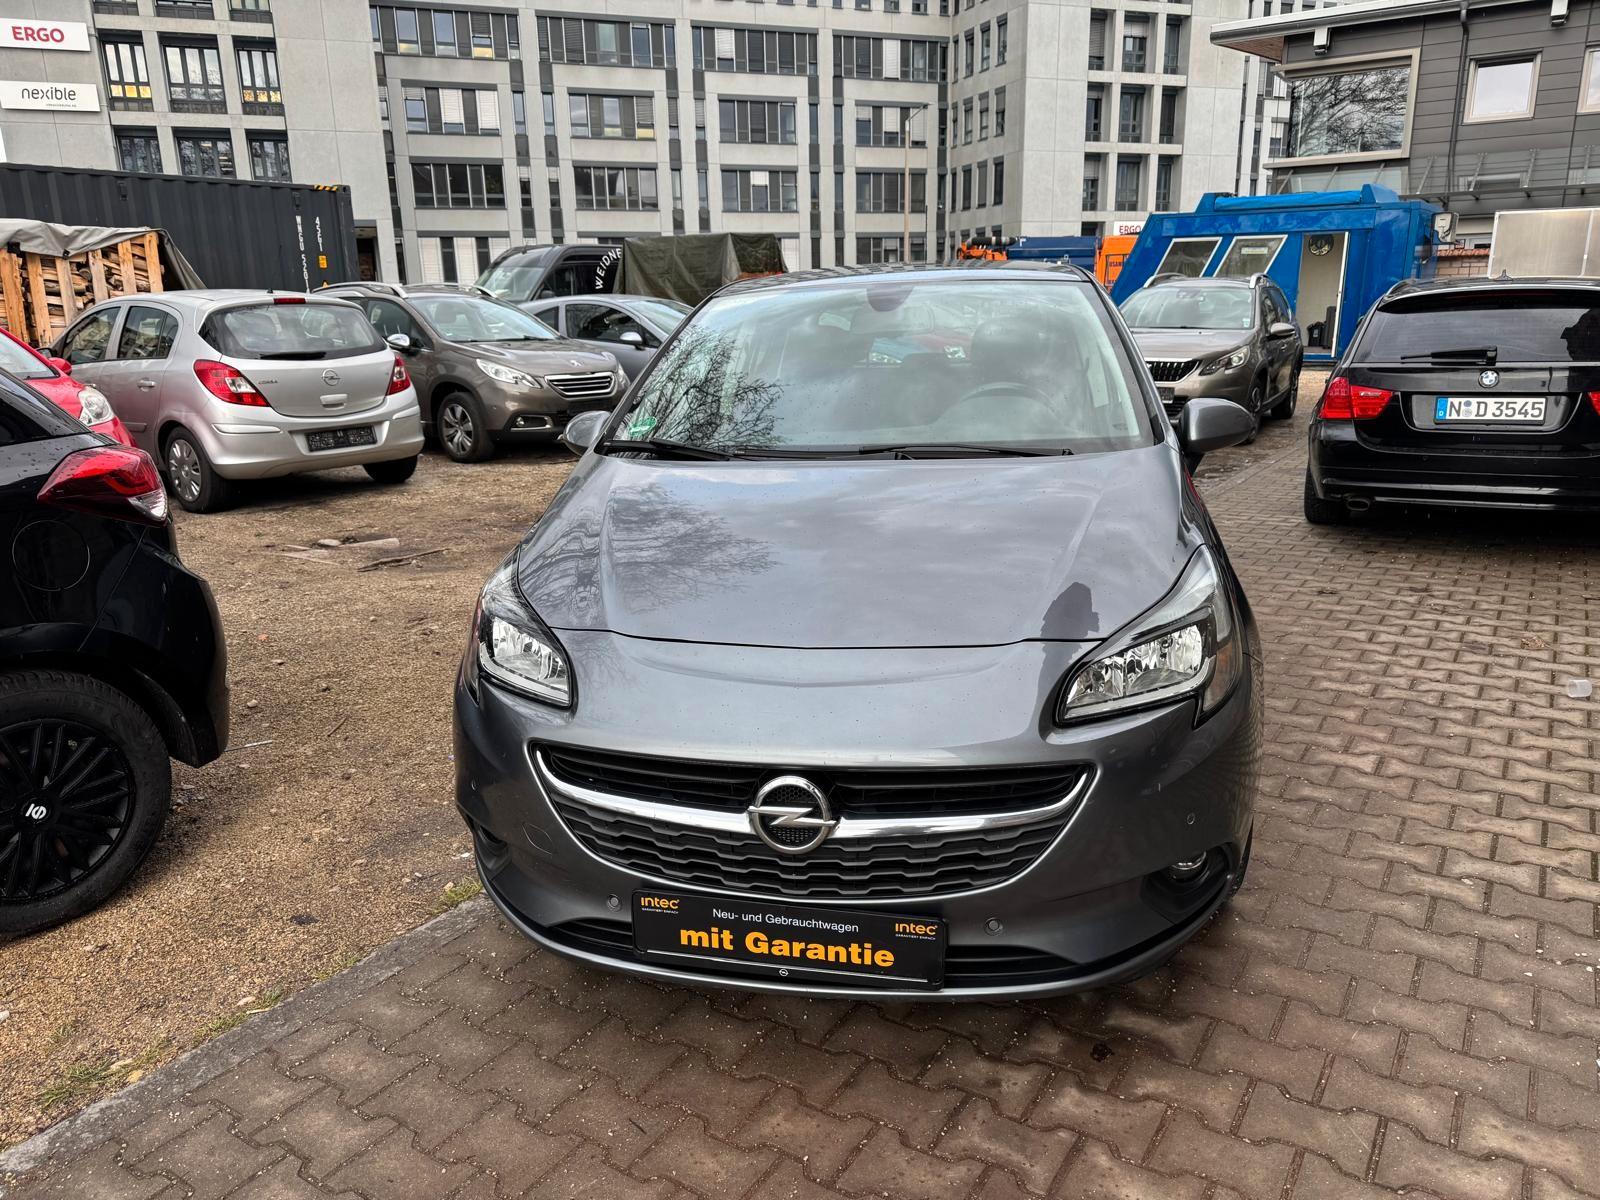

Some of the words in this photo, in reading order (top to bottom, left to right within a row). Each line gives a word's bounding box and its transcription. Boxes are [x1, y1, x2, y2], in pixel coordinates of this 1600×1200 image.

[11, 26, 65, 43] ERGO
[21, 87, 77, 101] nexible
[1119, 225, 1142, 234] ERGO
[1448, 401, 1463, 417] N
[1474, 401, 1488, 417] D
[1492, 401, 1544, 418] 3545
[641, 897, 680, 909] intec
[712, 908, 739, 920] Neu-
[742, 912, 762, 923] und
[765, 914, 859, 933] Gebrauchtwagen
[895, 922, 938, 935] intec
[680, 927, 734, 951] mit
[745, 931, 895, 967] Garantie
